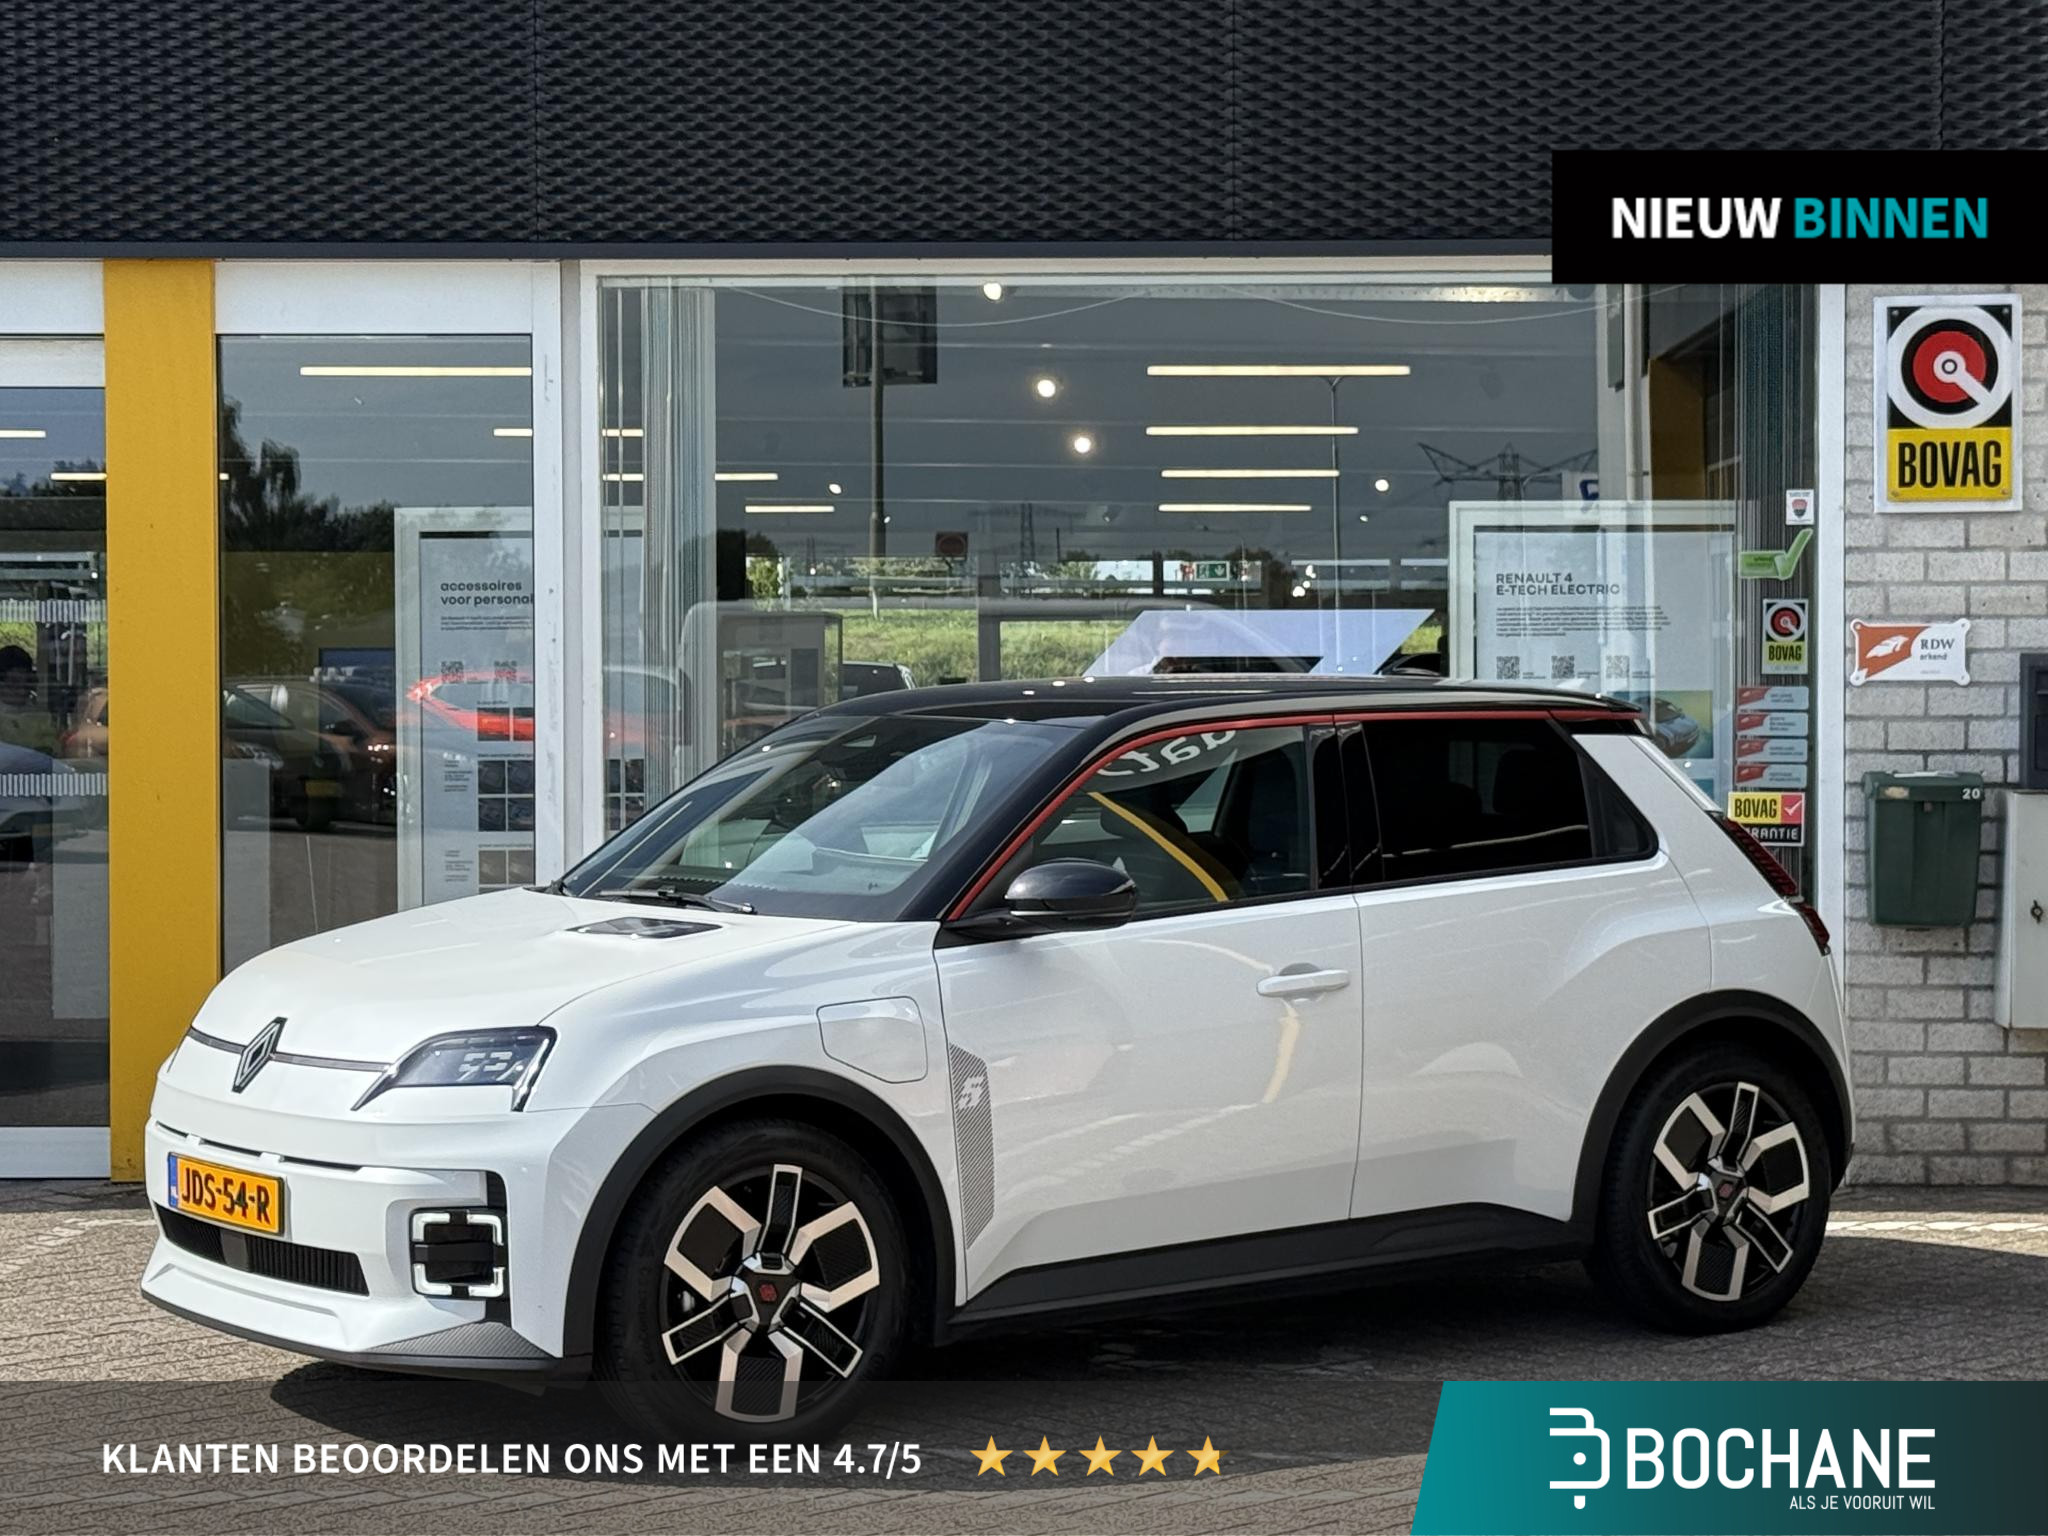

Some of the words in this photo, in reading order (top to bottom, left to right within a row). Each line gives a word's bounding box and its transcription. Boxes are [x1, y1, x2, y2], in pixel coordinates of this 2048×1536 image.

[1898, 440, 2002, 489] BOVAG
[1496, 573, 1561, 584] RENAULT
[1564, 572, 1573, 583] 4
[440, 579, 523, 592] accessoires
[1496, 584, 1548, 596] E-TECH
[1550, 583, 1621, 596] ELECTRIC
[440, 595, 472, 606] voor
[1920, 638, 1956, 651] RDW
[1767, 645, 1803, 662] BOVAG
[1962, 787, 1982, 800] 20
[1734, 798, 1778, 819] BOVAG
[181, 1166, 271, 1226] JDS-54-R
